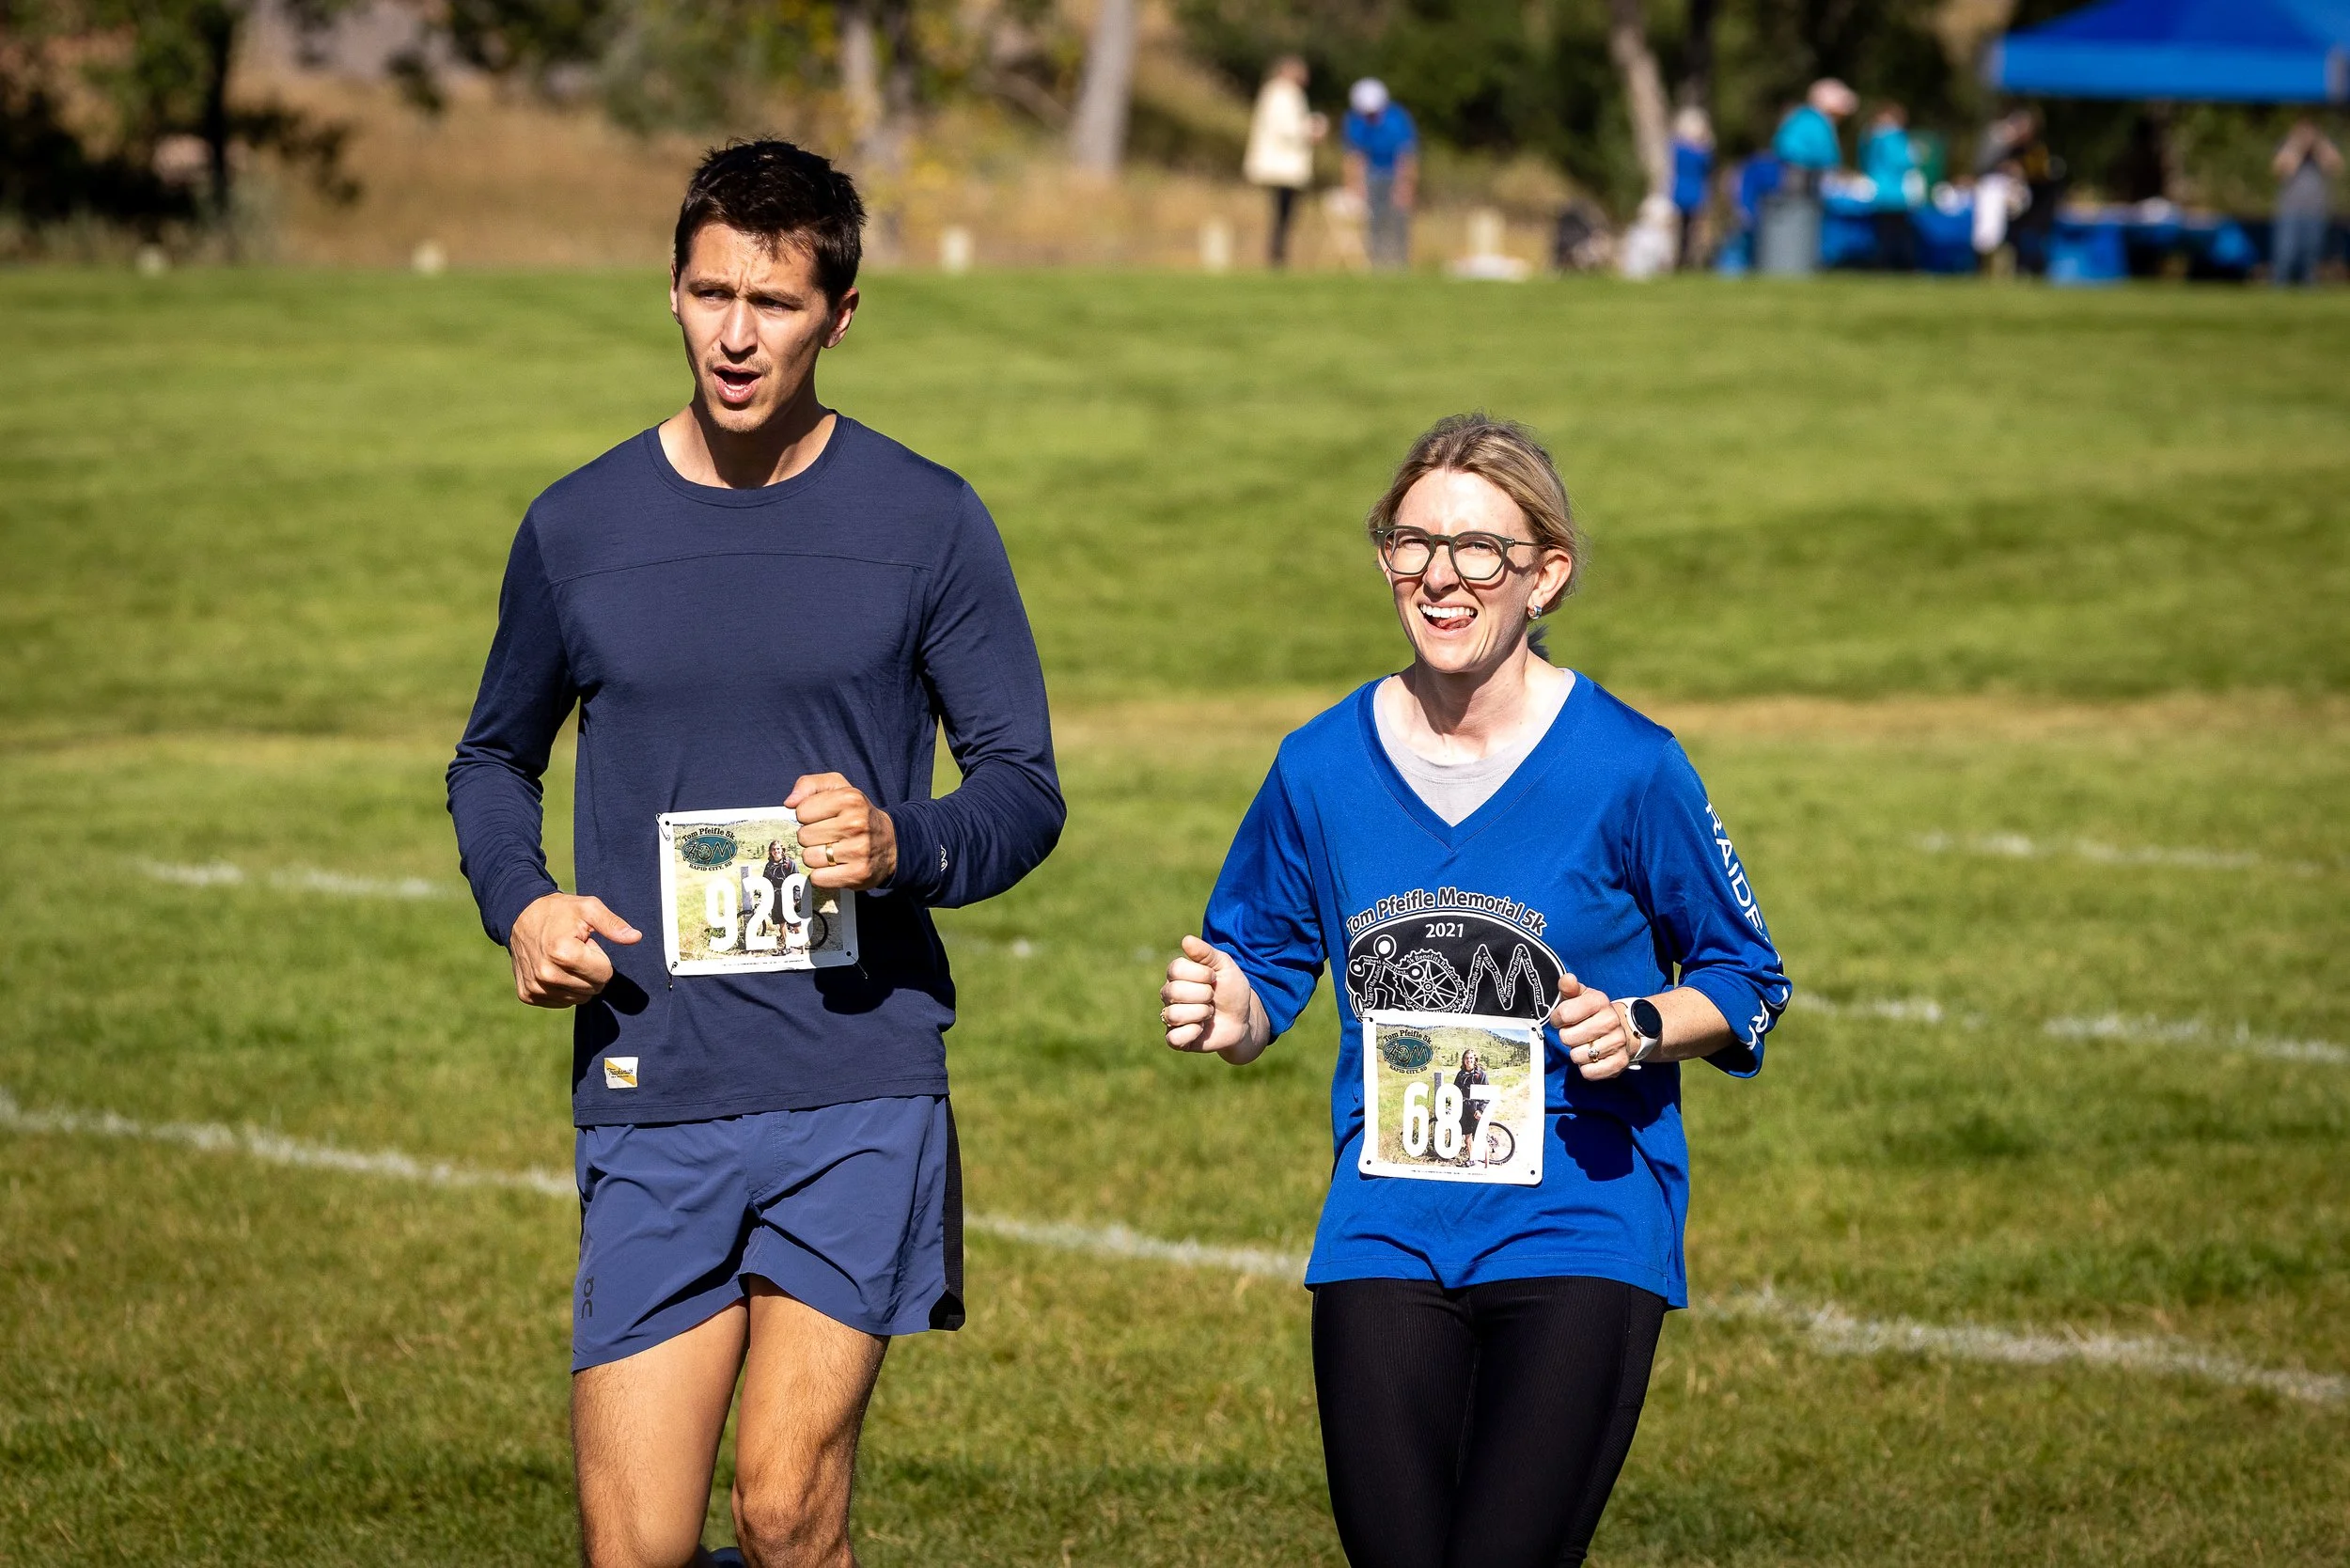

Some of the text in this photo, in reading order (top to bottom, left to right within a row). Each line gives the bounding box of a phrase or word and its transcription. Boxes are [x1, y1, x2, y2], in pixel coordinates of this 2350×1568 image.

[682, 826, 736, 841] Tom Pfeifle 5k
[705, 872, 814, 952] 929
[1346, 886, 1547, 936] Tom Pfeifle Memorial 5k
[1425, 922, 1465, 938] 2021
[1415, 954, 1440, 964] Benefits
[1523, 958, 1534, 973] Send
[1532, 978, 1543, 1005] postcard
[1383, 1032, 1399, 1042] Tom
[1422, 1035, 1433, 1044] 5k
[1402, 1082, 1502, 1161] 687
